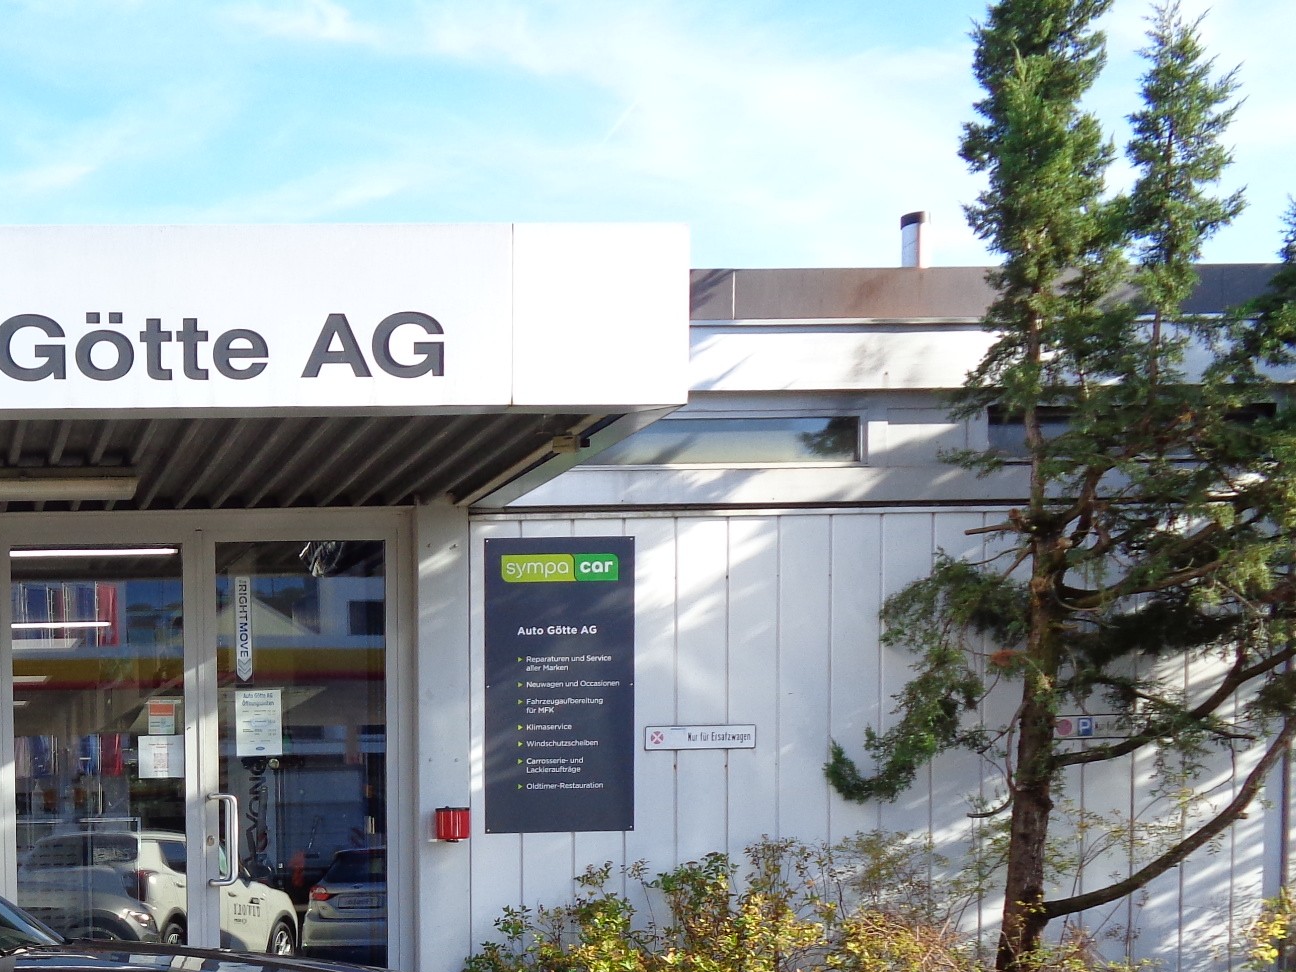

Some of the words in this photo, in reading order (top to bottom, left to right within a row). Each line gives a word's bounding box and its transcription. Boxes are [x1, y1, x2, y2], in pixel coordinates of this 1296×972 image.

[300, 310, 445, 379] AG
[506, 561, 569, 579] sympa
[579, 560, 614, 573] car
[238, 584, 248, 621] RIGHT
[517, 626, 544, 636] Auto
[547, 625, 578, 635] Götte
[580, 625, 598, 635] AG
[239, 622, 249, 658] MOVE
[526, 655, 570, 663] Reparaturen
[586, 654, 612, 662] Service
[526, 664, 541, 672] aller
[526, 681, 564, 689] Neuwagen
[579, 679, 620, 687] Occasionen
[526, 697, 604, 706] Fahrzeugaufbereitung
[526, 706, 537, 714] für
[537, 706, 555, 714] MFK
[526, 723, 573, 731] Klimaservice
[687, 732, 698, 742] Nur
[700, 731, 710, 742] für
[711, 731, 751, 743] Ersatzwagen
[526, 739, 599, 747] Windschutzscheiben
[526, 757, 569, 765] Carrosserie-
[570, 756, 584, 764] und
[526, 766, 581, 774] Lackieraufträge
[526, 781, 604, 790] Oldtimer-Restauration
